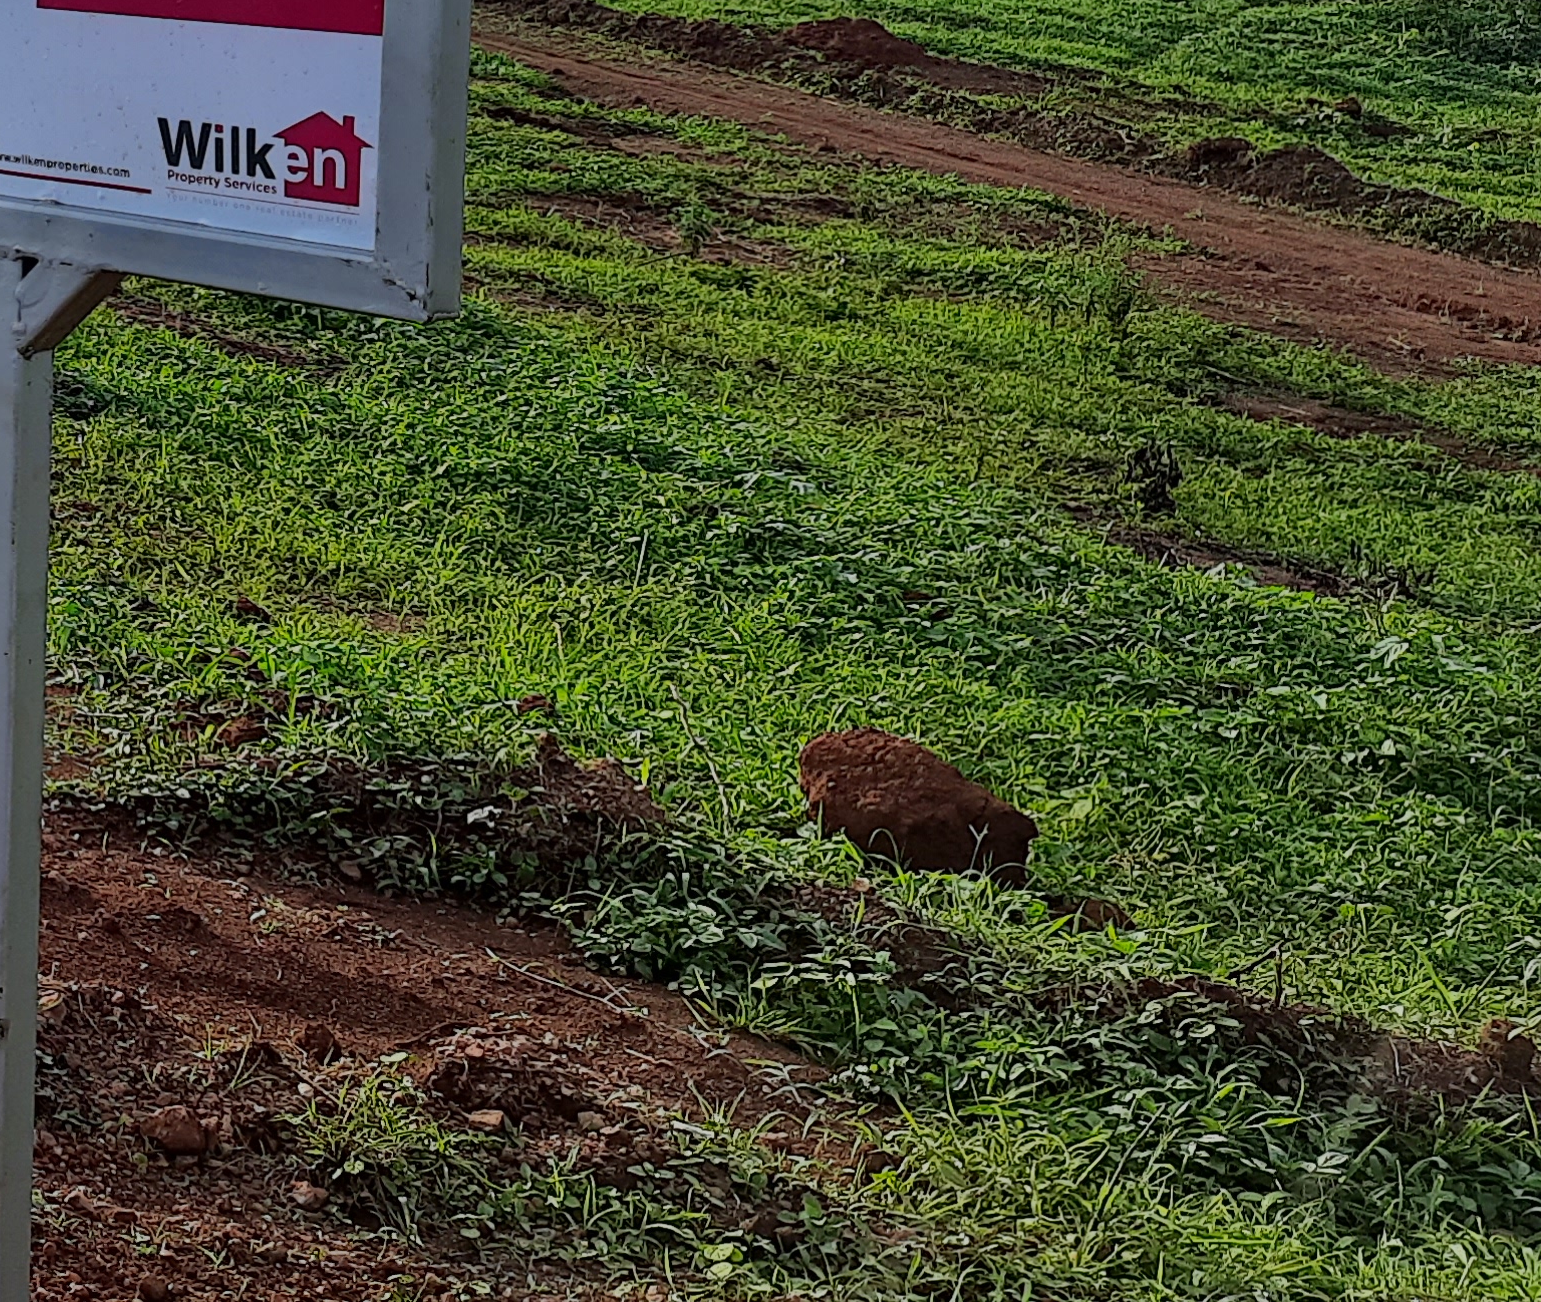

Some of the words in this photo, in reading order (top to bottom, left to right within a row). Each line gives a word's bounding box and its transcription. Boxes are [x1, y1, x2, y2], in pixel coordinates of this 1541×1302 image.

[157, 117, 346, 189] Wilken
[167, 169, 220, 189] Property
[224, 177, 277, 195] Services
